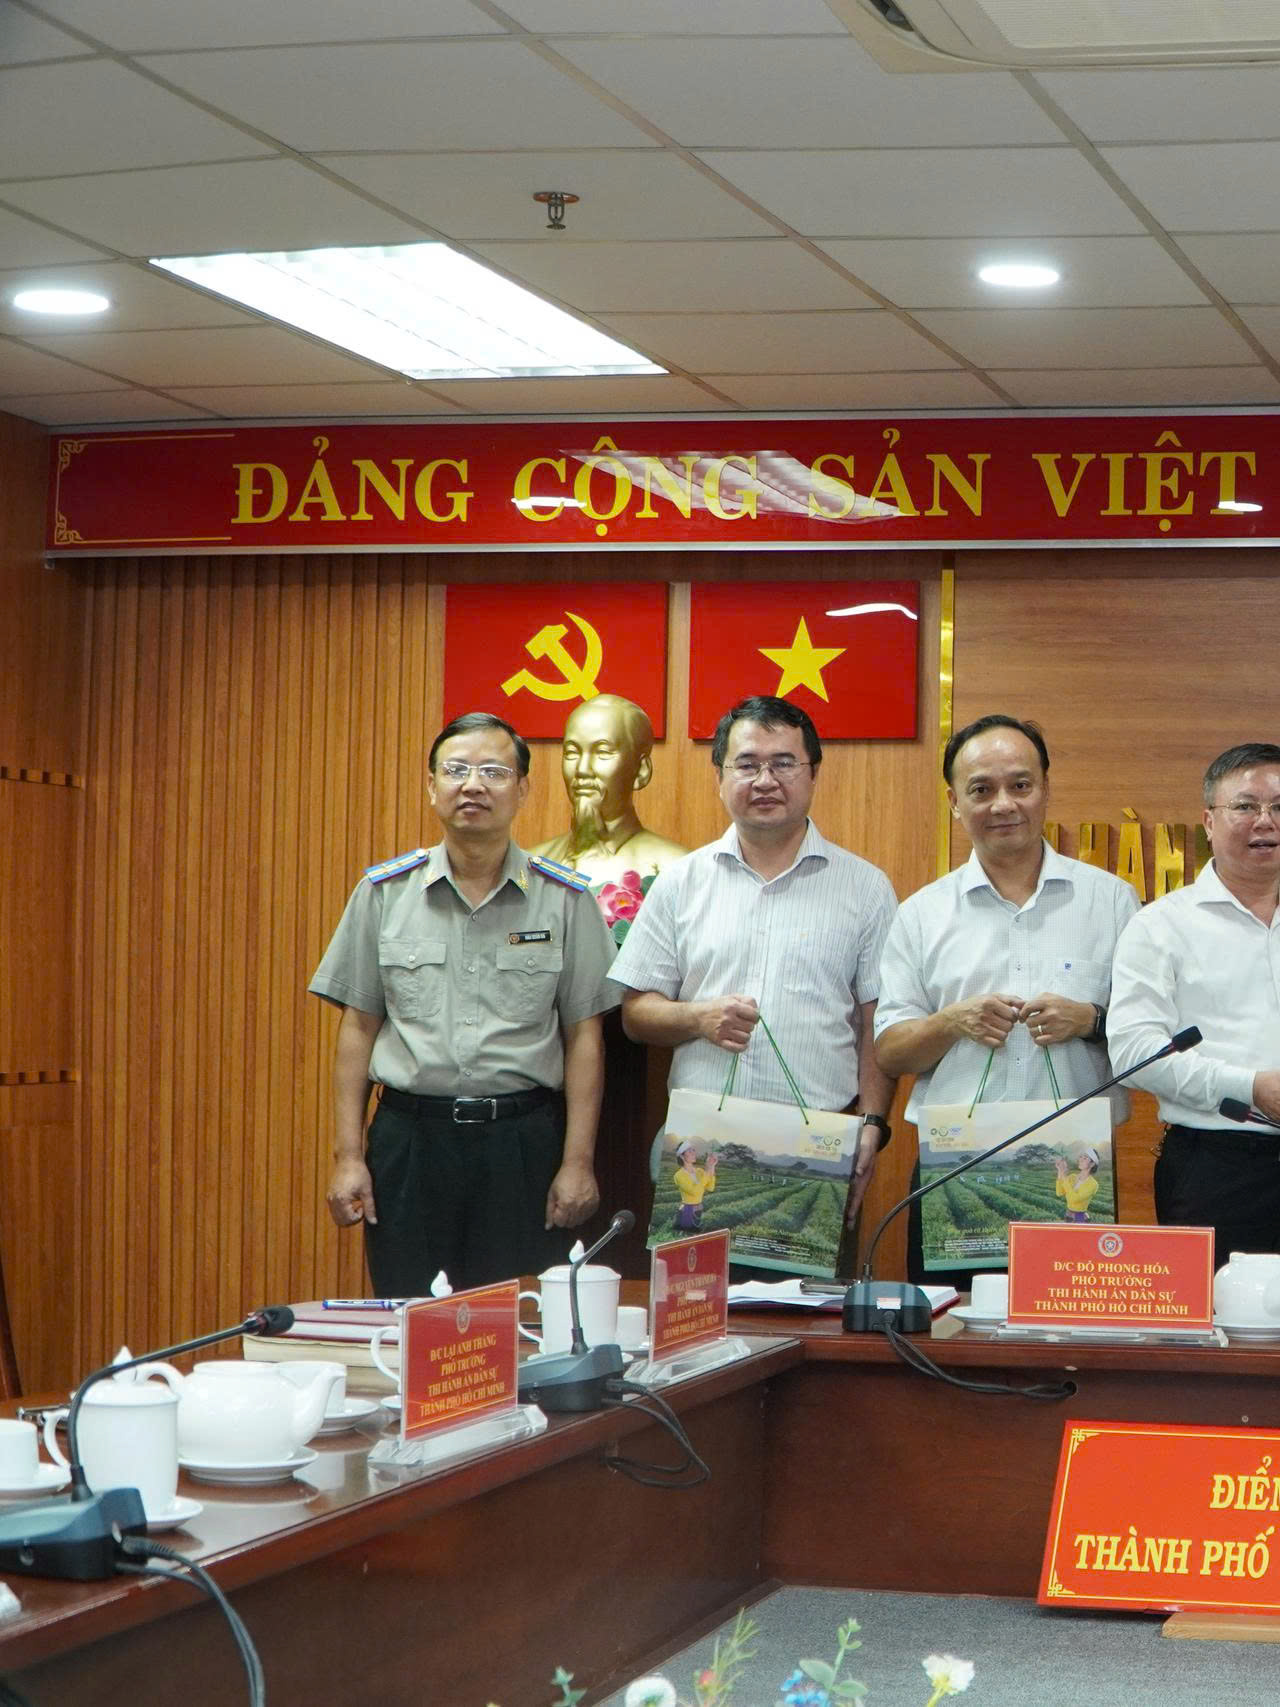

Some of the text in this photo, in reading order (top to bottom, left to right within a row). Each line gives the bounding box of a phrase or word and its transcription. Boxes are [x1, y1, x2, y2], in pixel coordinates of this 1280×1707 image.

[232, 436, 474, 524] ĐẢNG
[512, 438, 763, 536] CỘNG
[808, 428, 991, 519] SẢN
[1033, 430, 1260, 532] VIỆT
[1078, 807, 1212, 903] HÀN
[1054, 1261, 1074, 1272] Đ/C
[1098, 1263, 1140, 1274] PHONG
[1071, 1273, 1152, 1287] PHÓ TRƯỞNG
[1047, 1287, 1176, 1304] THI HÀNH ÁN DÂN SỰ
[1034, 1300, 1077, 1312] THÀNH
[1130, 1302, 1152, 1314] CHÍ
[1154, 1304, 1188, 1315] MINH
[1074, 1525, 1193, 1575] THÀNH
[1200, 1525, 1277, 1579] PHỐ
